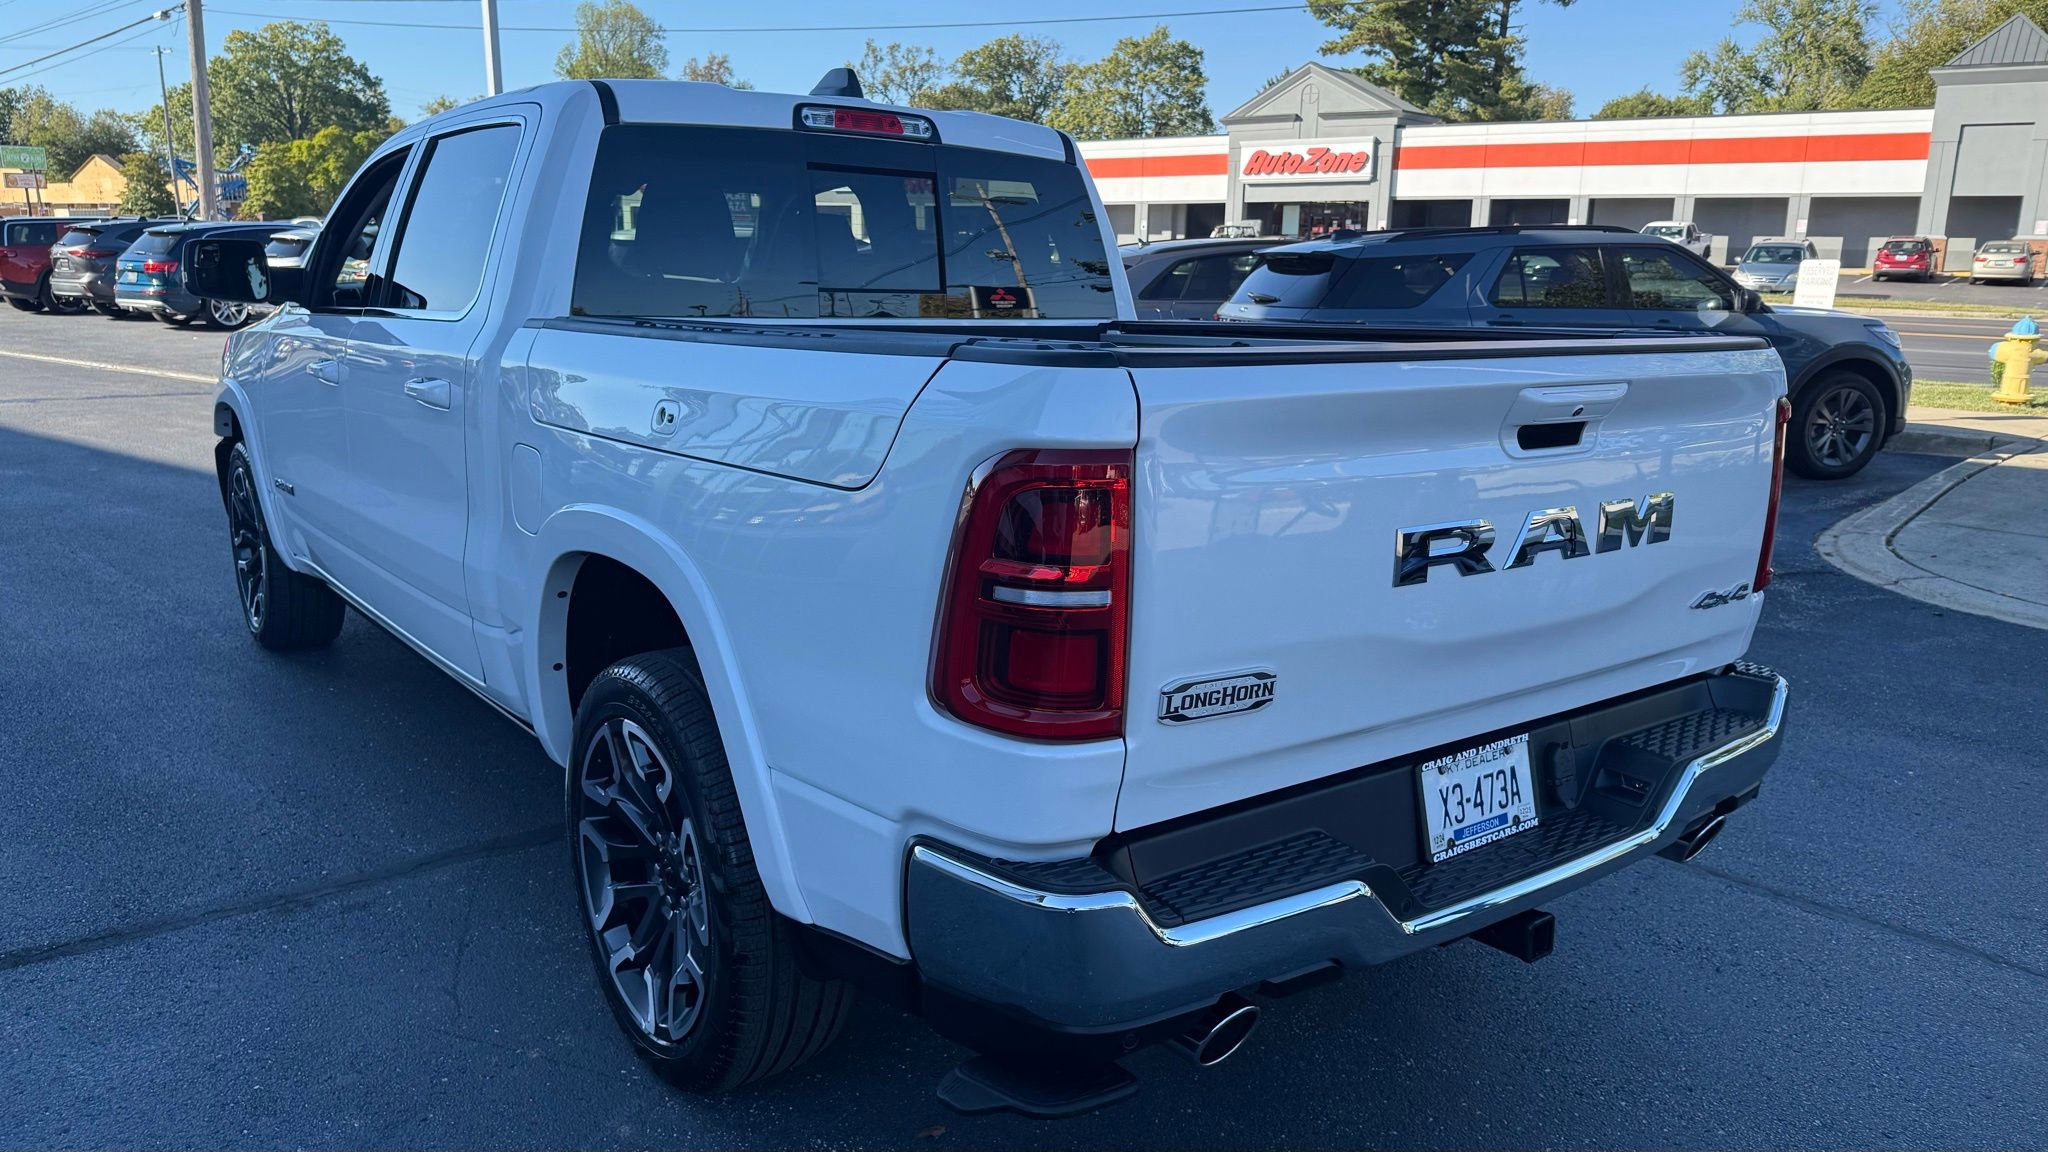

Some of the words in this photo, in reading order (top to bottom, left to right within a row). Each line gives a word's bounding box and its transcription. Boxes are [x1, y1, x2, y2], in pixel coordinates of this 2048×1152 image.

[1243, 147, 1369, 175] AutoZone
[1392, 492, 1675, 587] RAM
[1164, 680, 1277, 716] LONGHORN
[1422, 755, 1454, 772] CRAIG
[1455, 748, 1477, 762] AND
[1478, 733, 1529, 756] LANDRETH
[1465, 749, 1505, 769] DEALER
[1439, 765, 1522, 829] X3-473A
[1433, 817, 1539, 863] CRAIGSBESTCARS.COM
[1462, 817, 1500, 838] JEFFERSON
